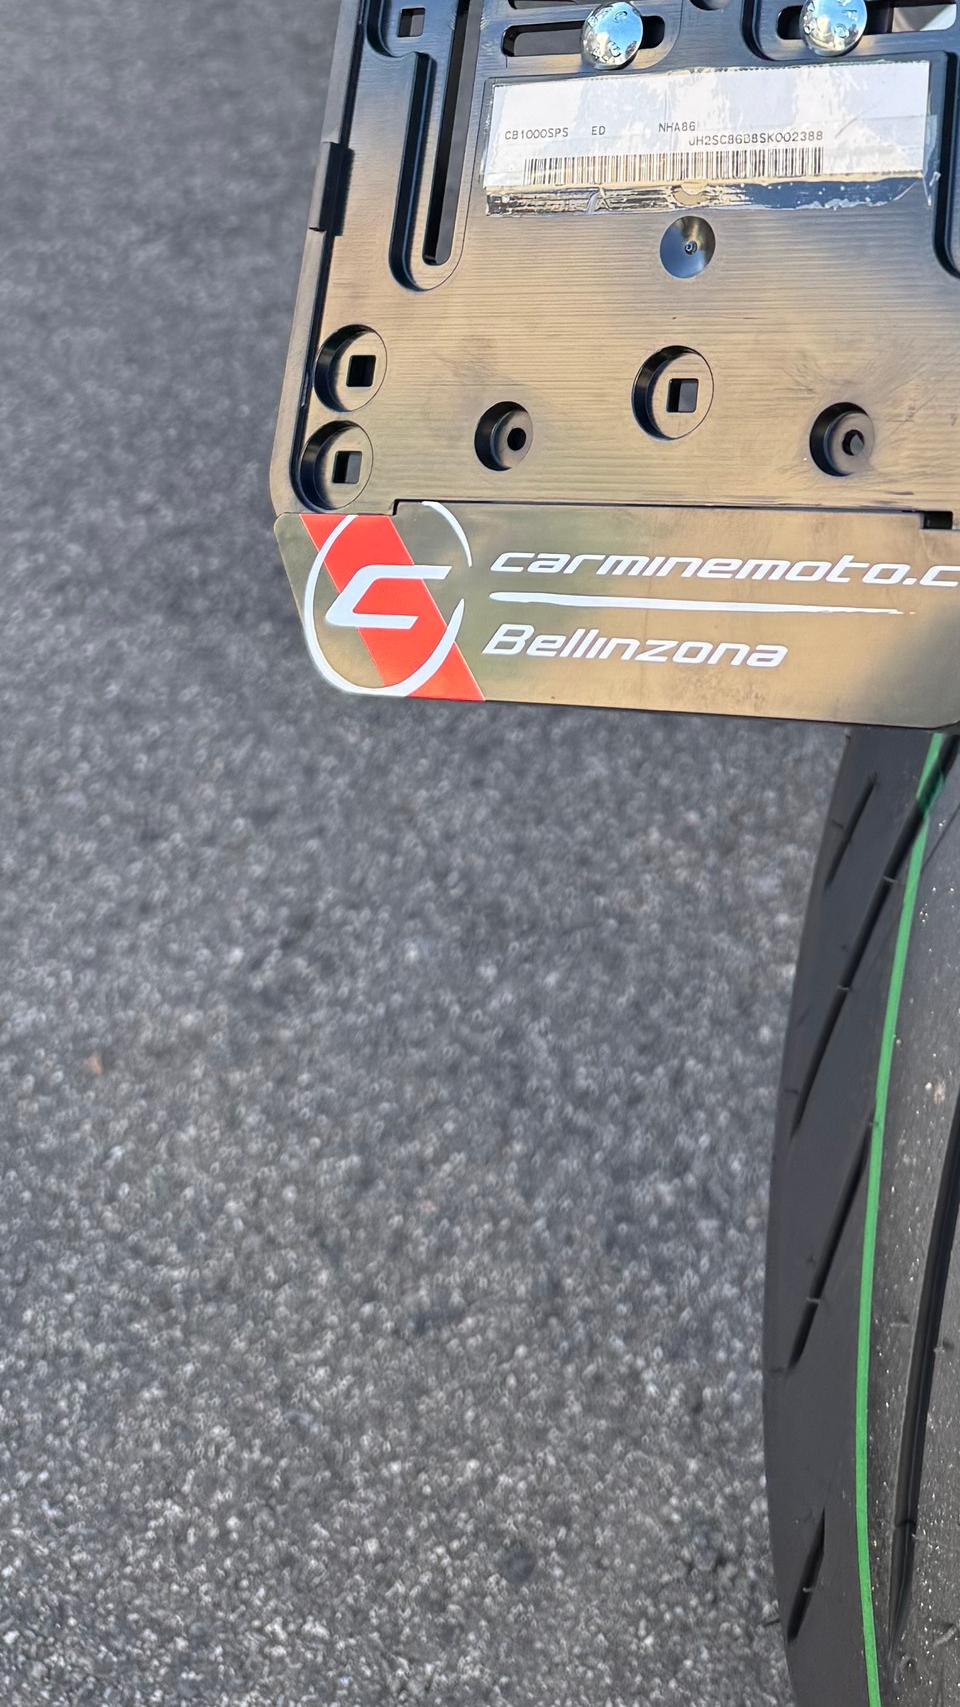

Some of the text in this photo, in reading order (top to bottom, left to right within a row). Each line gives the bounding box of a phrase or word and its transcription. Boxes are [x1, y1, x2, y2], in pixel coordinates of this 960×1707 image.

[504, 121, 696, 141] CB1000SPS ED NHA86
[688, 130, 824, 146] JH2SC86B8SK002388
[482, 623, 788, 668] Bellinzona
